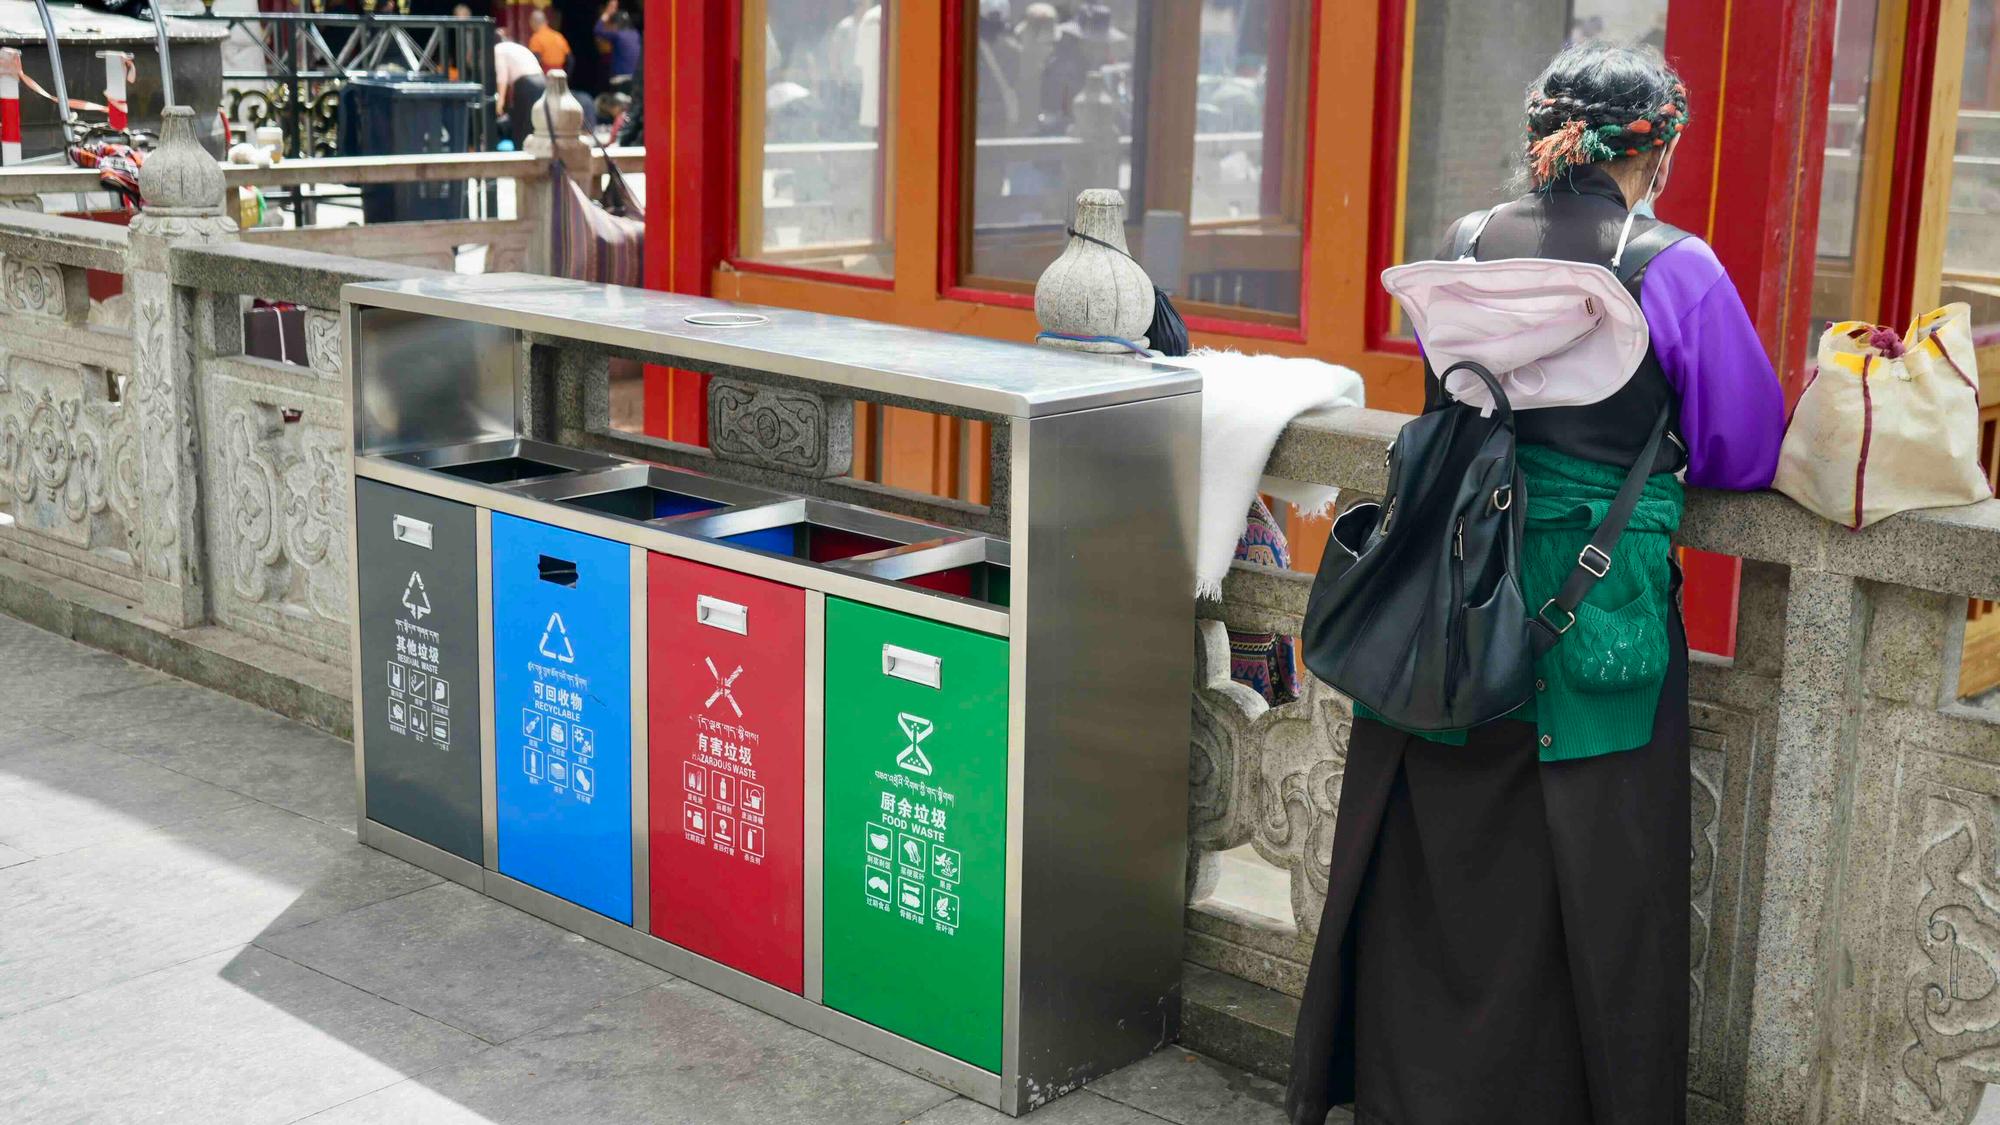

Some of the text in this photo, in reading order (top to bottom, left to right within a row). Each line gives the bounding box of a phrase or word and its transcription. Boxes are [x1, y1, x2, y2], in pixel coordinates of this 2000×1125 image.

[396, 635, 440, 664] 其他垃圾
[421, 661, 439, 675] WASTE
[533, 680, 583, 711] 可回收物
[535, 700, 581, 722] RECYCLABLE
[697, 732, 753, 767] 有害垃圾
[733, 764, 757, 779] WASTE
[880, 791, 947, 830] 厨余垃圾
[882, 813, 945, 843] FOOD WASTE
[866, 896, 891, 912] 过期食品
[935, 922, 955, 936] 茶叶渣
